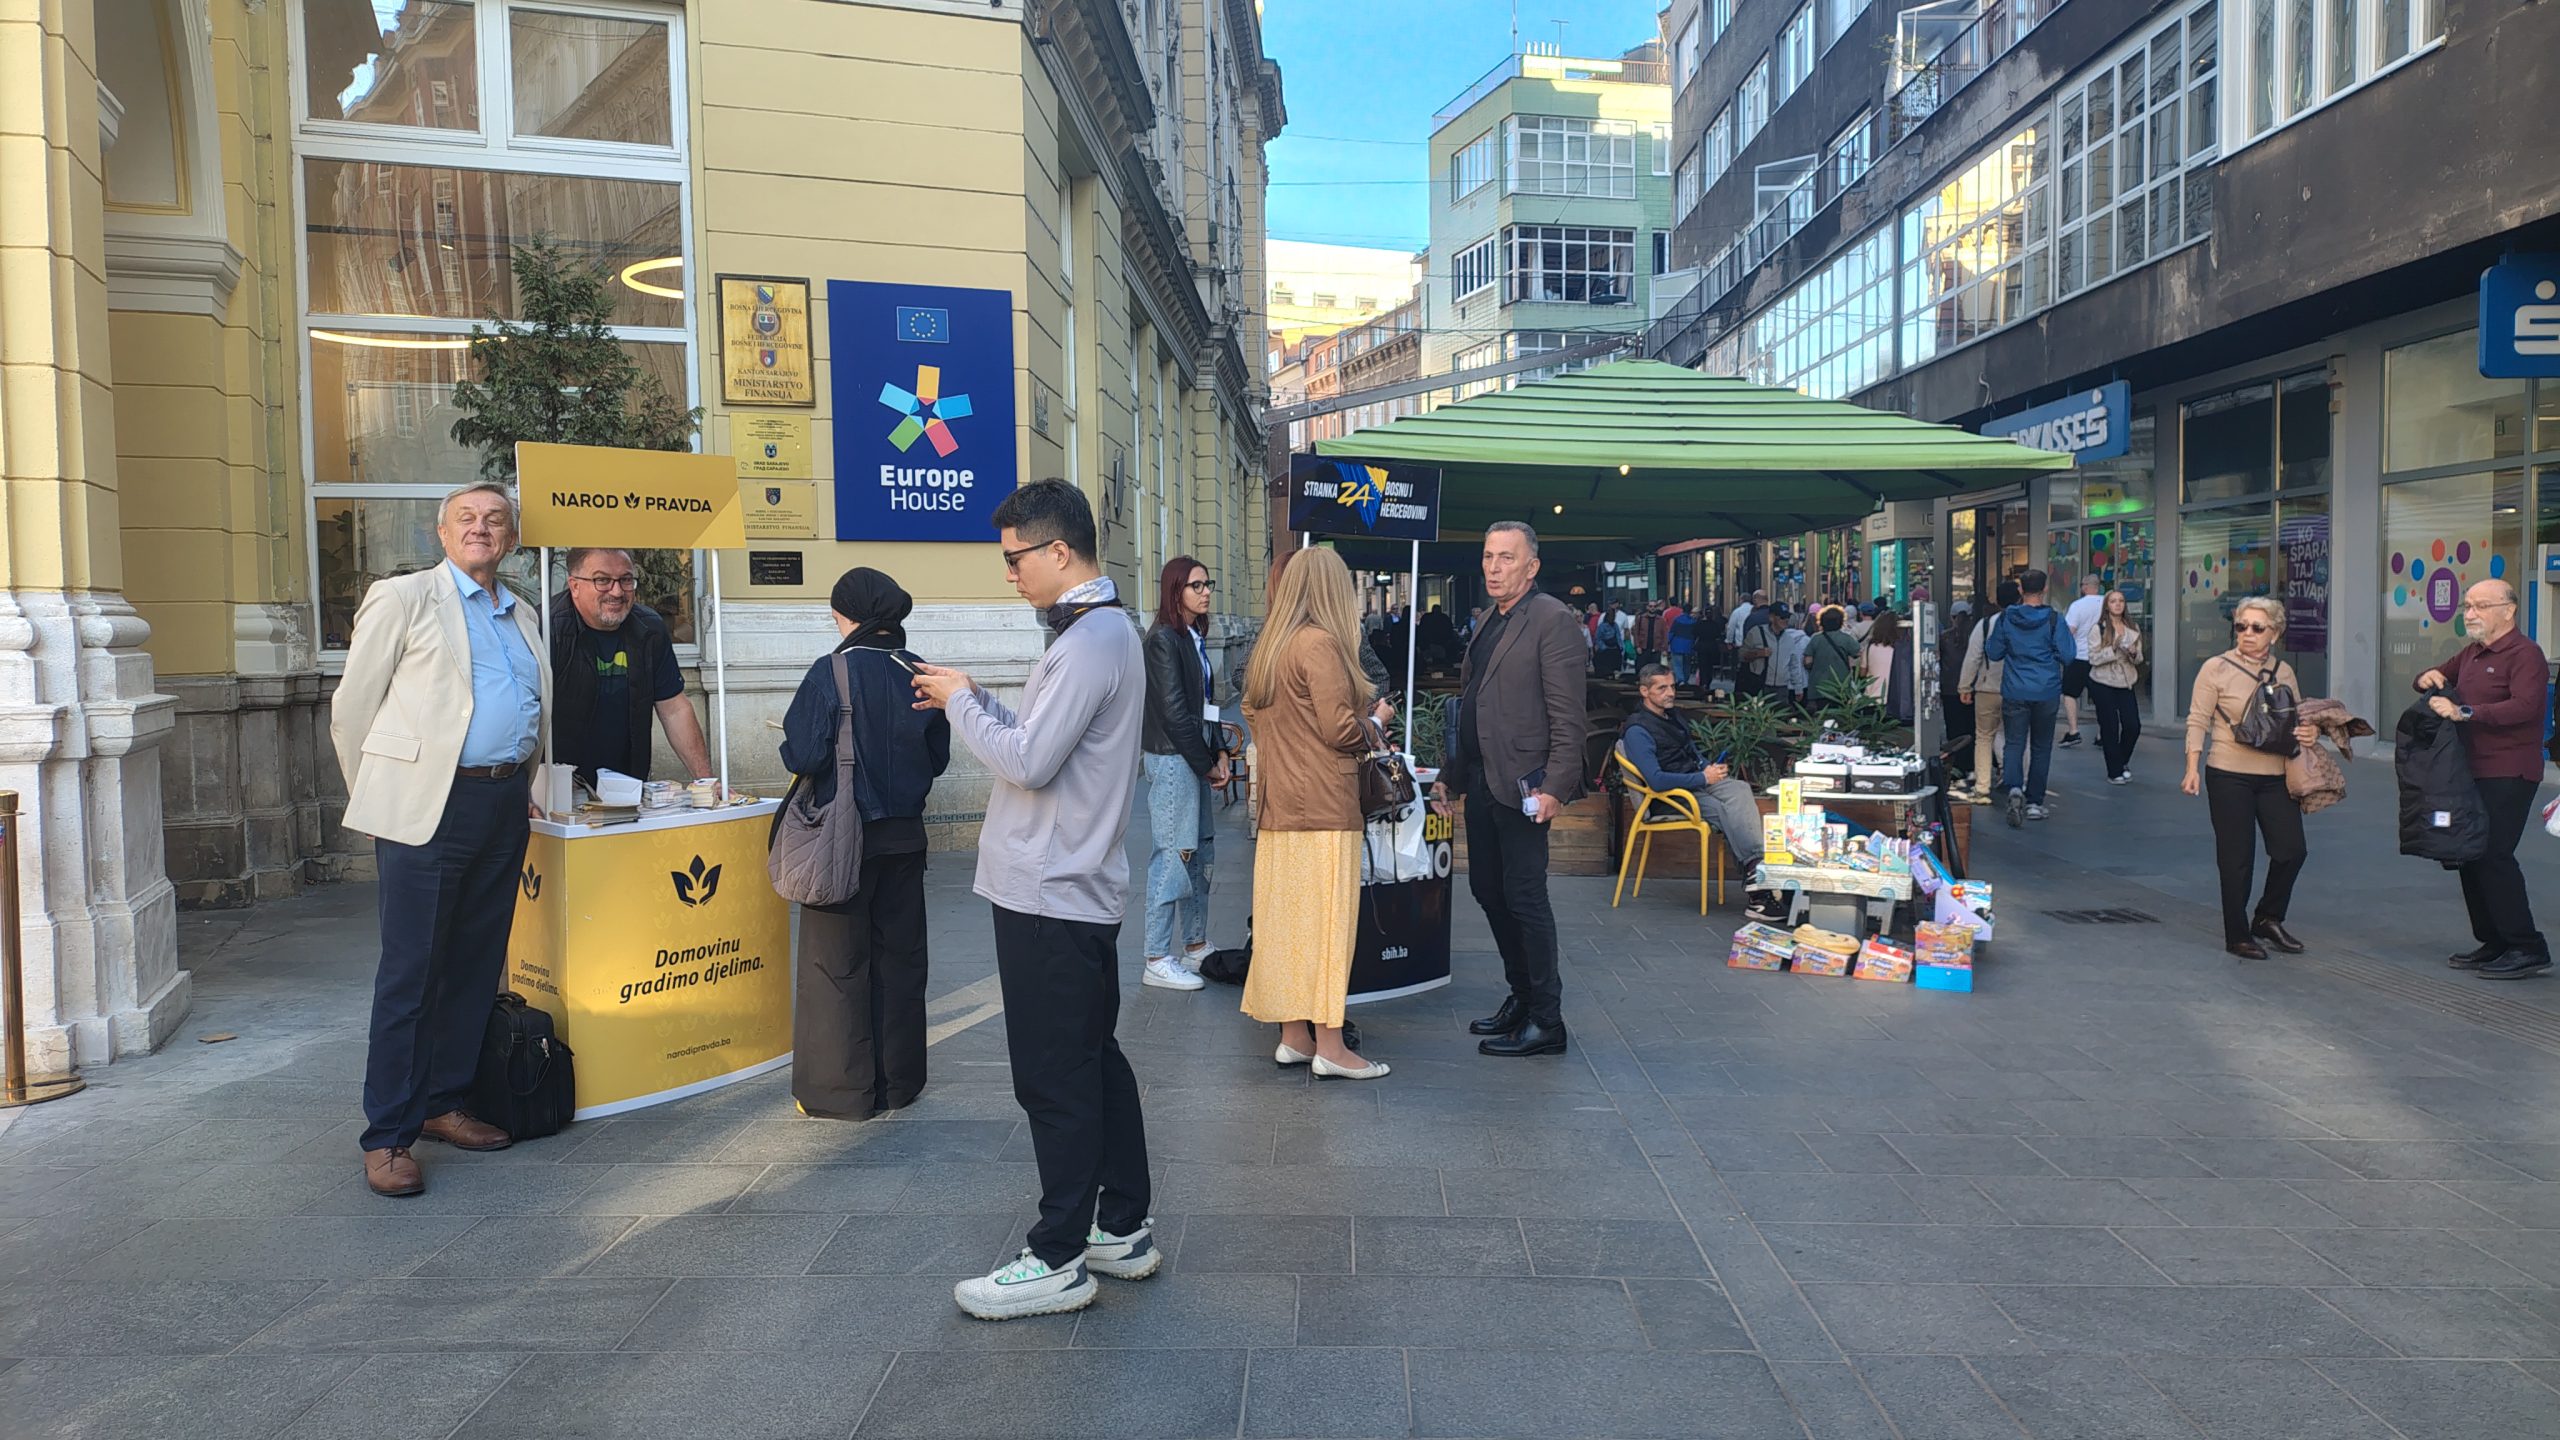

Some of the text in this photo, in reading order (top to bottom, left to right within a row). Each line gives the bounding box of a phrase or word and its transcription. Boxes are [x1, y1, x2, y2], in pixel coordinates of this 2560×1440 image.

[730, 304, 751, 312] BOSNA
[734, 378, 804, 390] MINISTARSTVO
[766, 370, 798, 378] SARAJEVO
[745, 388, 793, 400] FINANSIJA
[880, 464, 974, 492] Europe
[552, 492, 713, 513] NAROD PRAVDA
[891, 488, 966, 511] House
[1304, 480, 1339, 499] STRANKA
[1337, 481, 1375, 508] ZA
[1385, 480, 1409, 498] BOSNU
[1380, 502, 1428, 521] HERCEGOVINU
[2294, 562, 2313, 579] TAJ
[1425, 814, 1453, 842] BiH
[655, 938, 741, 969] Domovinu
[1381, 946, 1408, 961] sbih.ba
[520, 959, 550, 978] Domovinu
[512, 973, 559, 997] gradimo djelima.
[620, 955, 765, 1004] gradimo djelima.
[666, 1037, 731, 1060] narodipravda.ba
